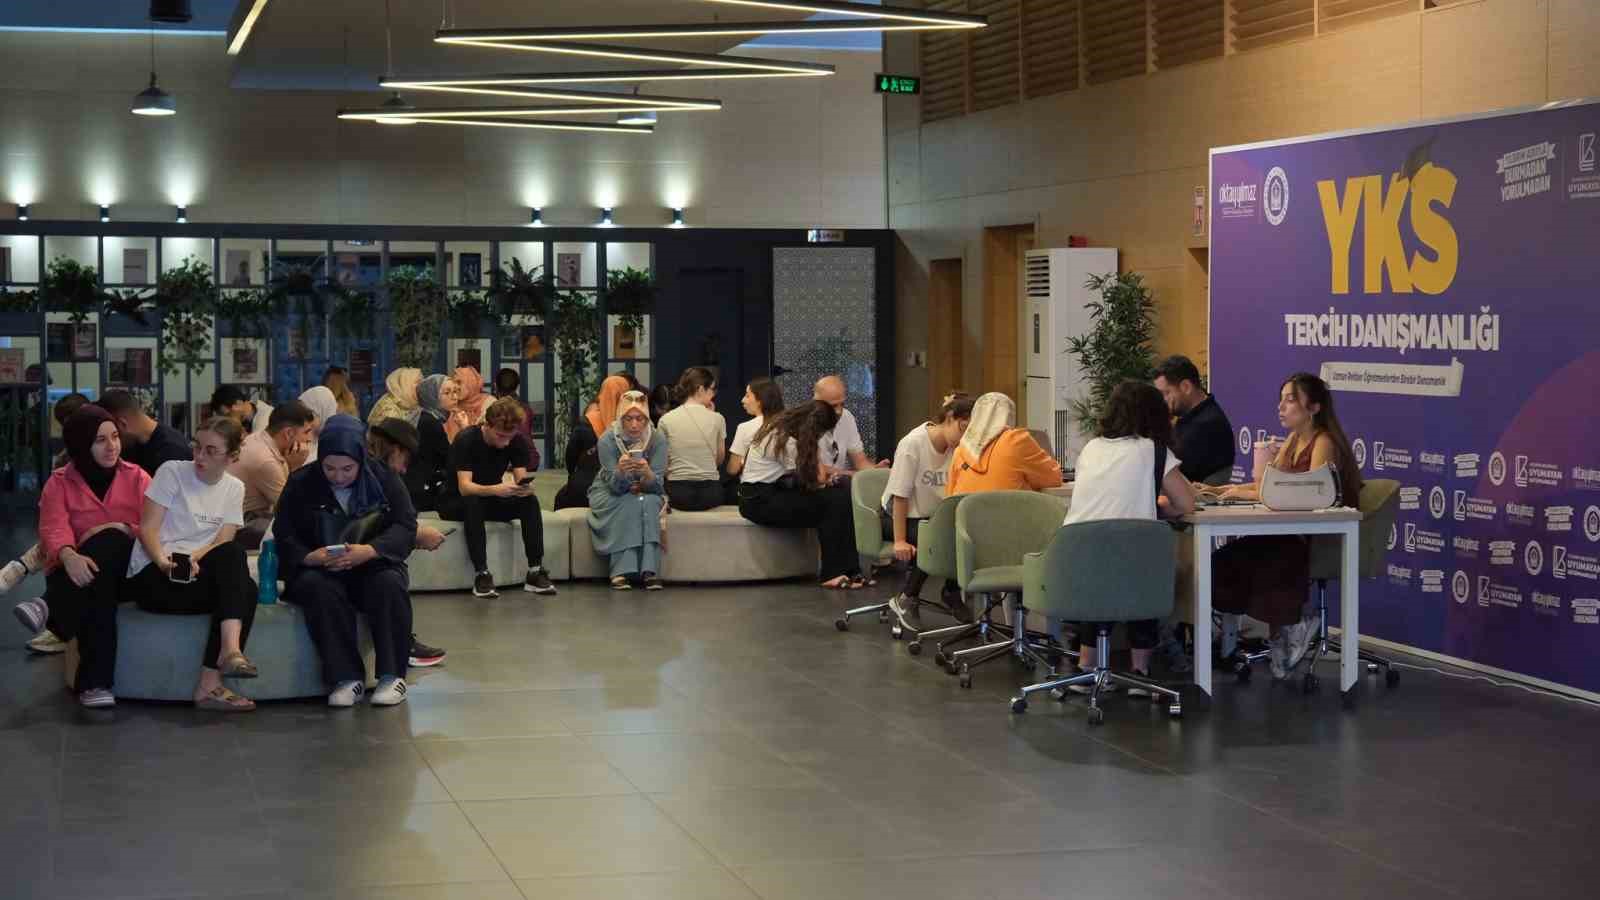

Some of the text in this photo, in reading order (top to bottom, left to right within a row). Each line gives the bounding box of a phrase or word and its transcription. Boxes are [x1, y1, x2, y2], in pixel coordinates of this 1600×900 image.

[1317, 161, 1458, 295] YKS
[1285, 305, 1499, 355] TERCİH DANIŞMANLIĞI
